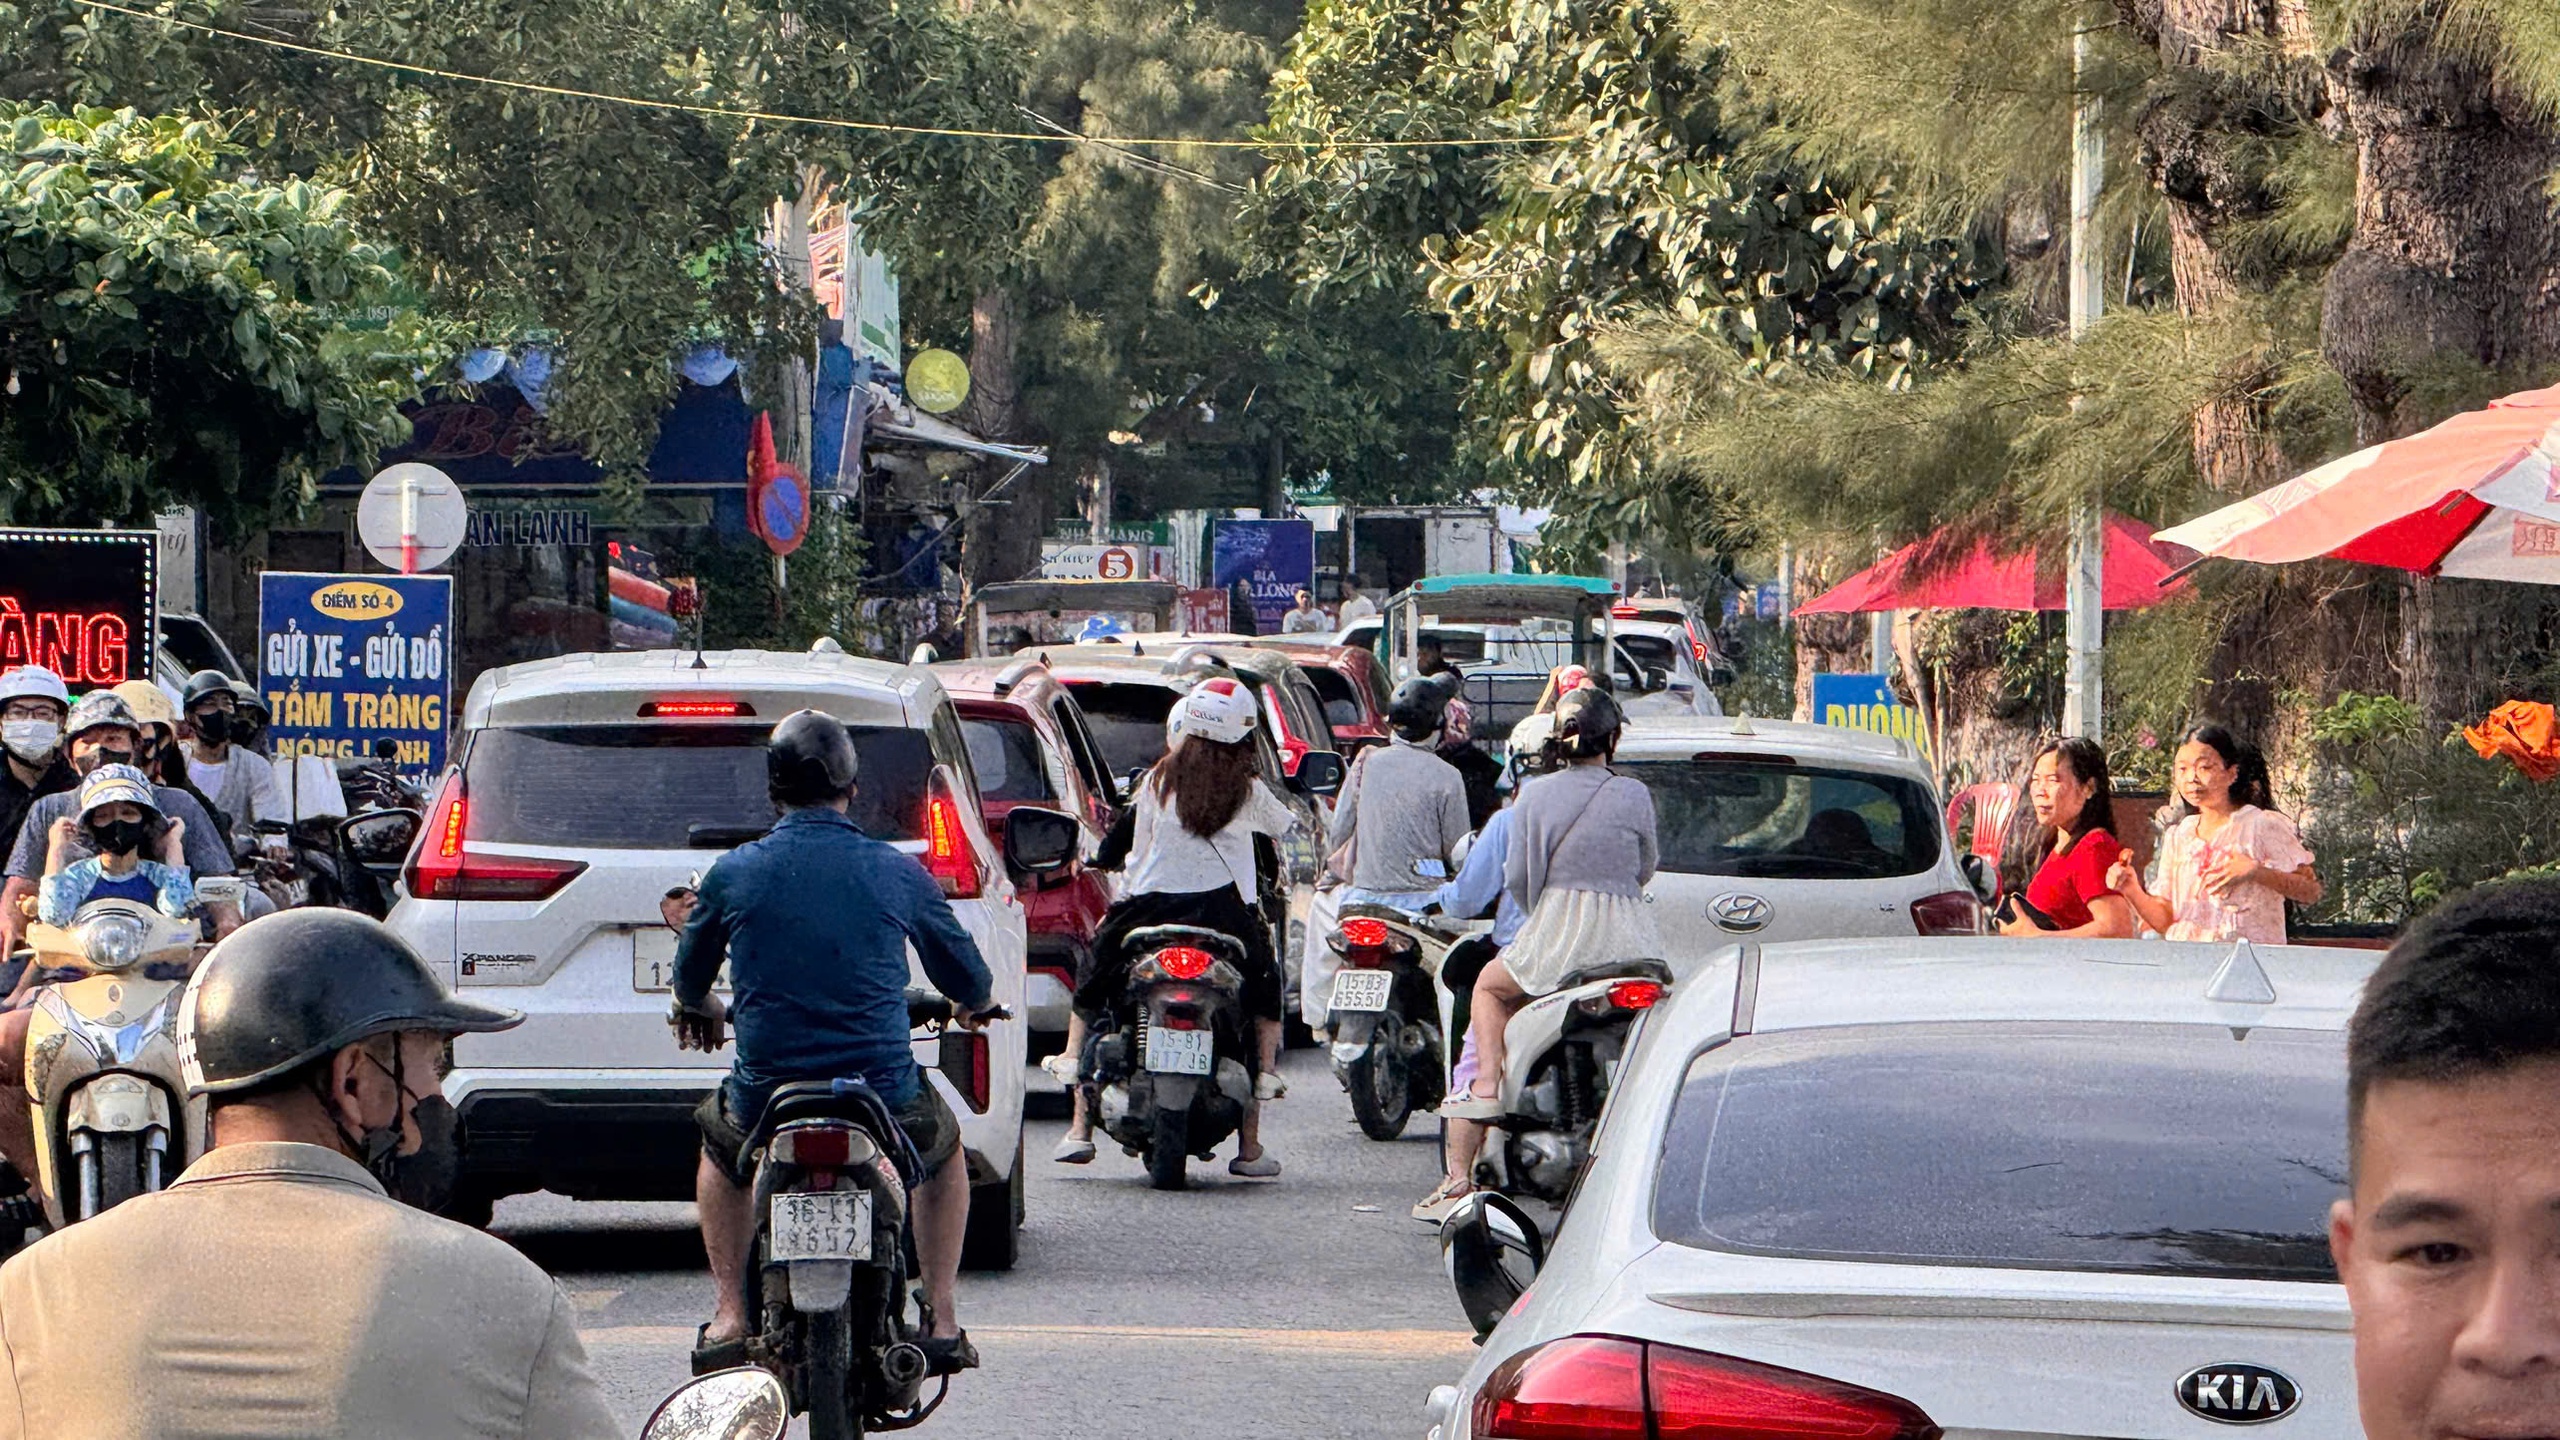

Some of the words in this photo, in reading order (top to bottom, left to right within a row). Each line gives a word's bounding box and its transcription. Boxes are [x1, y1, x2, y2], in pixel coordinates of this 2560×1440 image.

[1105, 554, 1127, 578] 5
[384, 594, 394, 609] 4
[267, 618, 308, 677] GỬI
[312, 634, 343, 678] XE
[365, 620, 406, 680] GỬI
[362, 738, 430, 765] LNH
[2197, 1374, 2280, 1411] KIA
